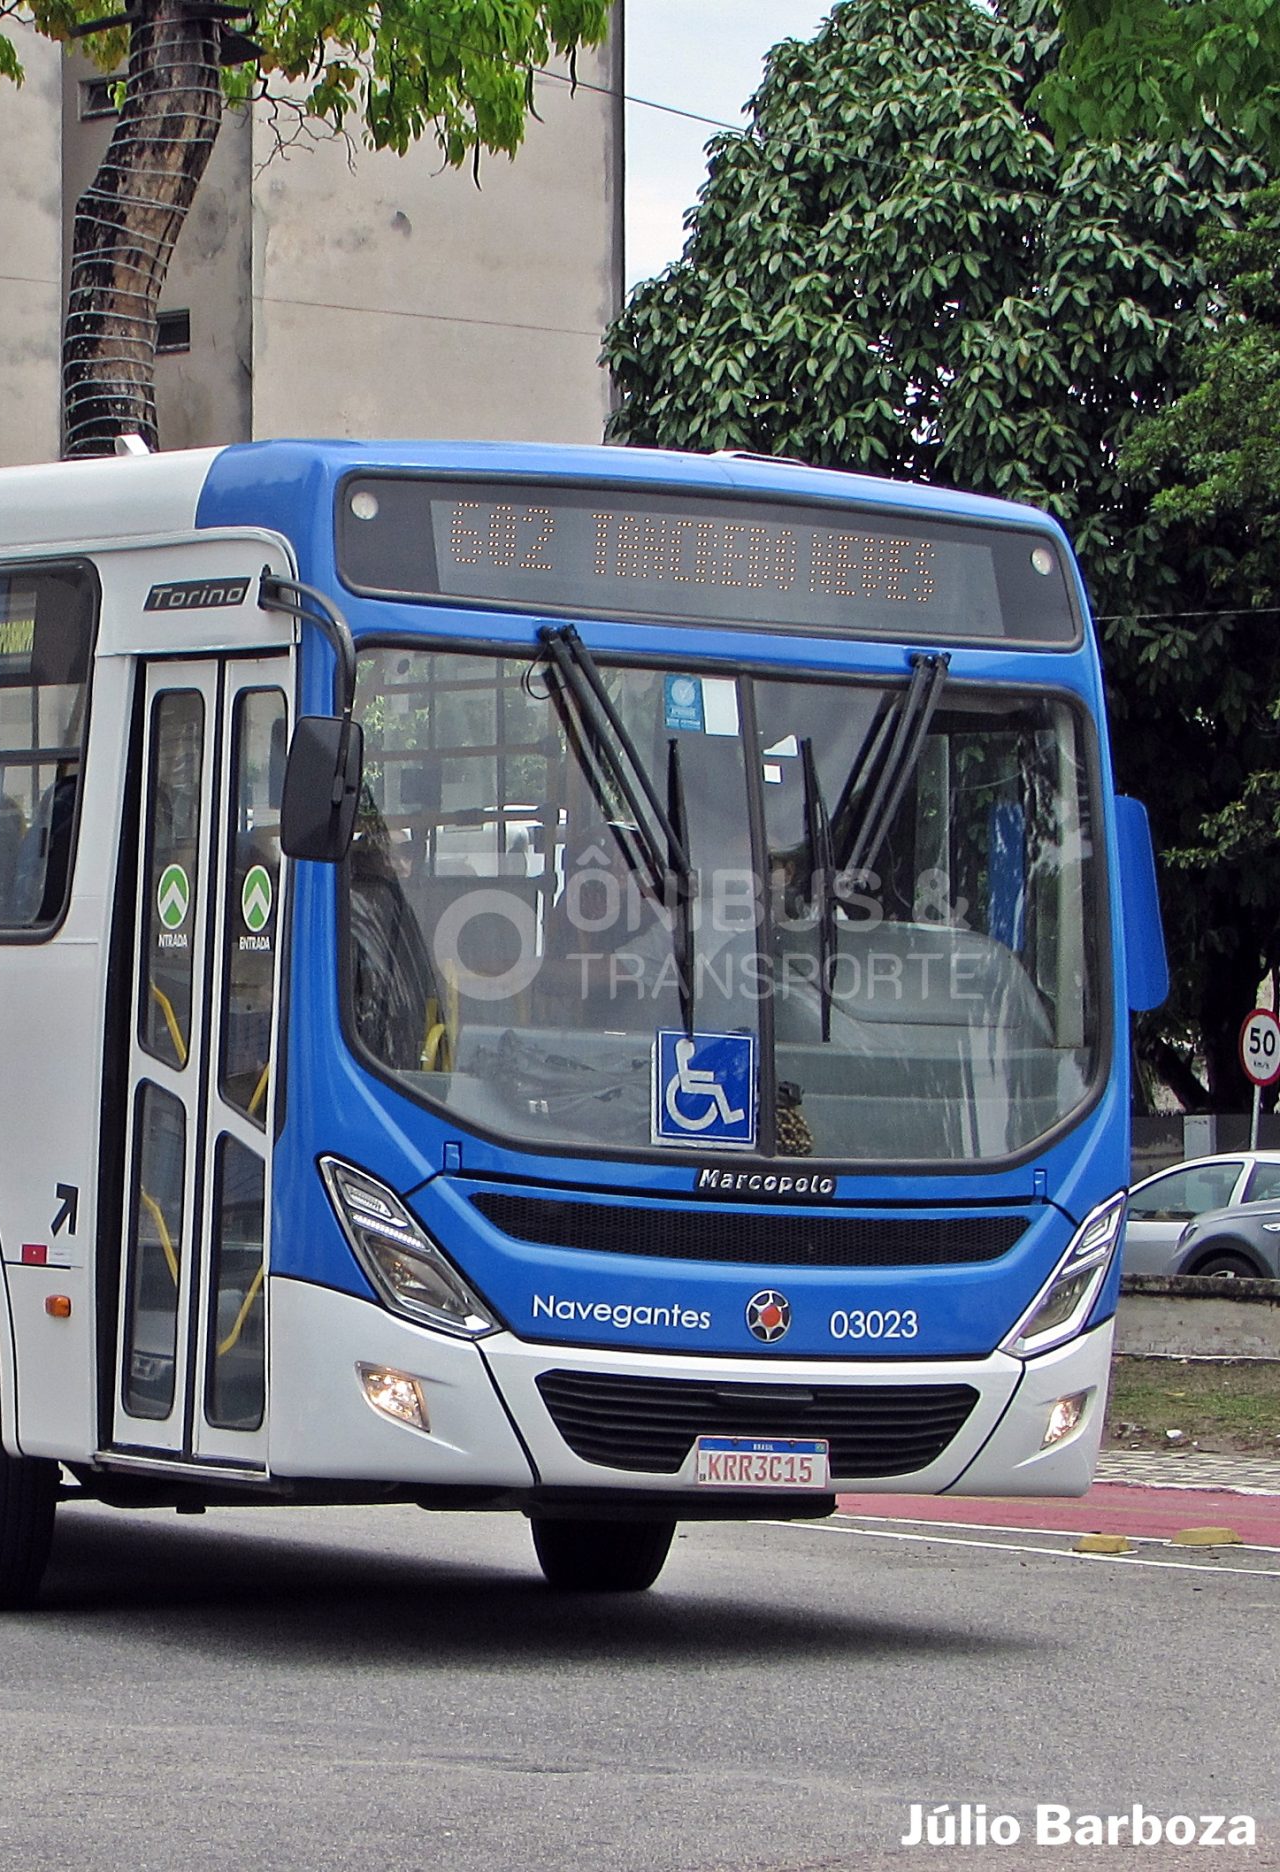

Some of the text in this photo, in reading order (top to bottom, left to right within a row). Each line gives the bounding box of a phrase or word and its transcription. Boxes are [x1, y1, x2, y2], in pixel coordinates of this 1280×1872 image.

[450, 502, 554, 569] 602
[151, 584, 245, 608] Torino
[239, 936, 271, 950] ENTRADA
[1249, 1026, 1276, 1057] 50
[698, 1167, 835, 1196] Marcopolo
[531, 1294, 712, 1331] Navegantes
[830, 1309, 918, 1340] 03023
[707, 1453, 813, 1483] KRR3C15
